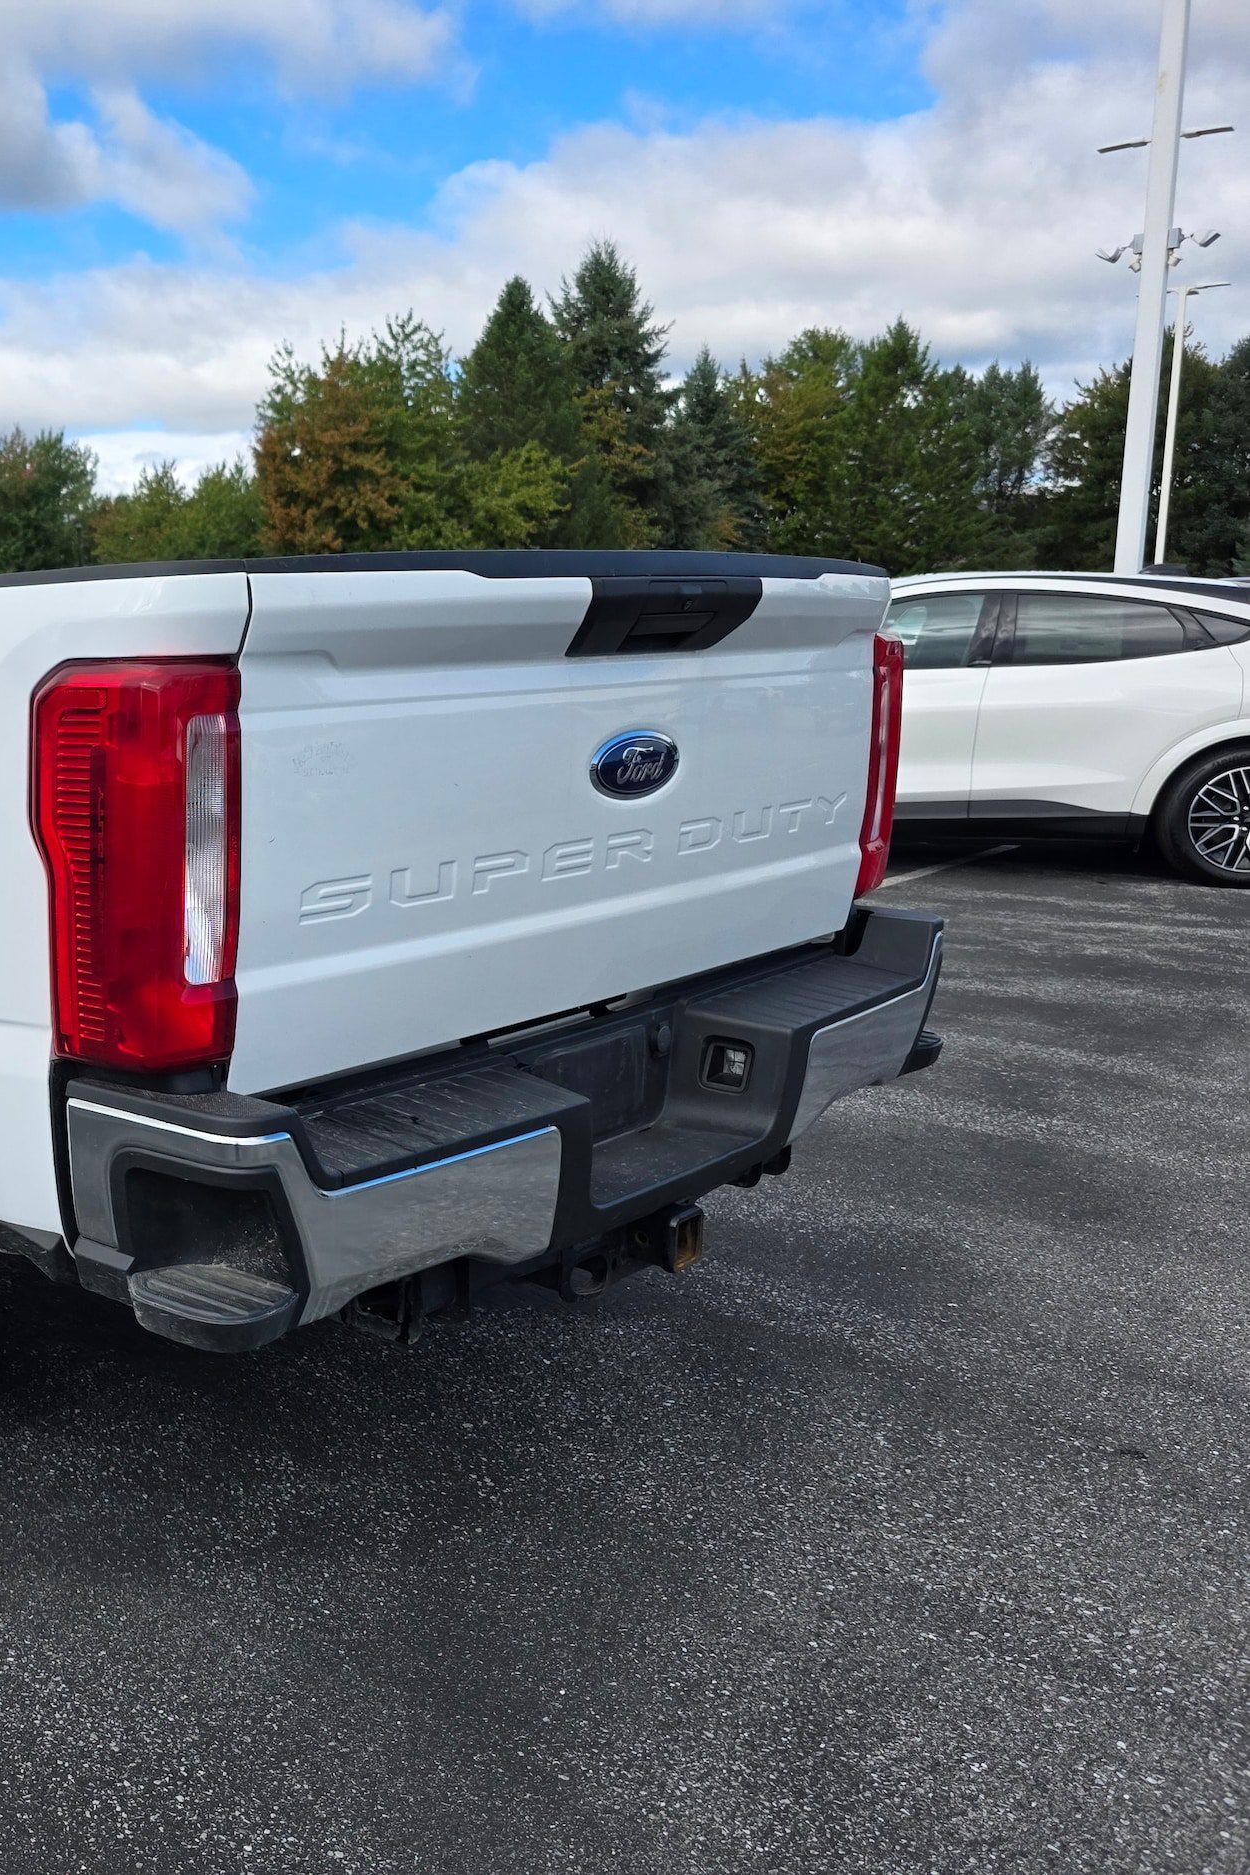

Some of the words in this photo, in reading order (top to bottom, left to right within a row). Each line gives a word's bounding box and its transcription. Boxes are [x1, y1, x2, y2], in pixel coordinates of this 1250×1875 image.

[616, 745, 666, 786] Ford
[298, 827, 655, 926] SUPER
[676, 790, 848, 856] DUTY
